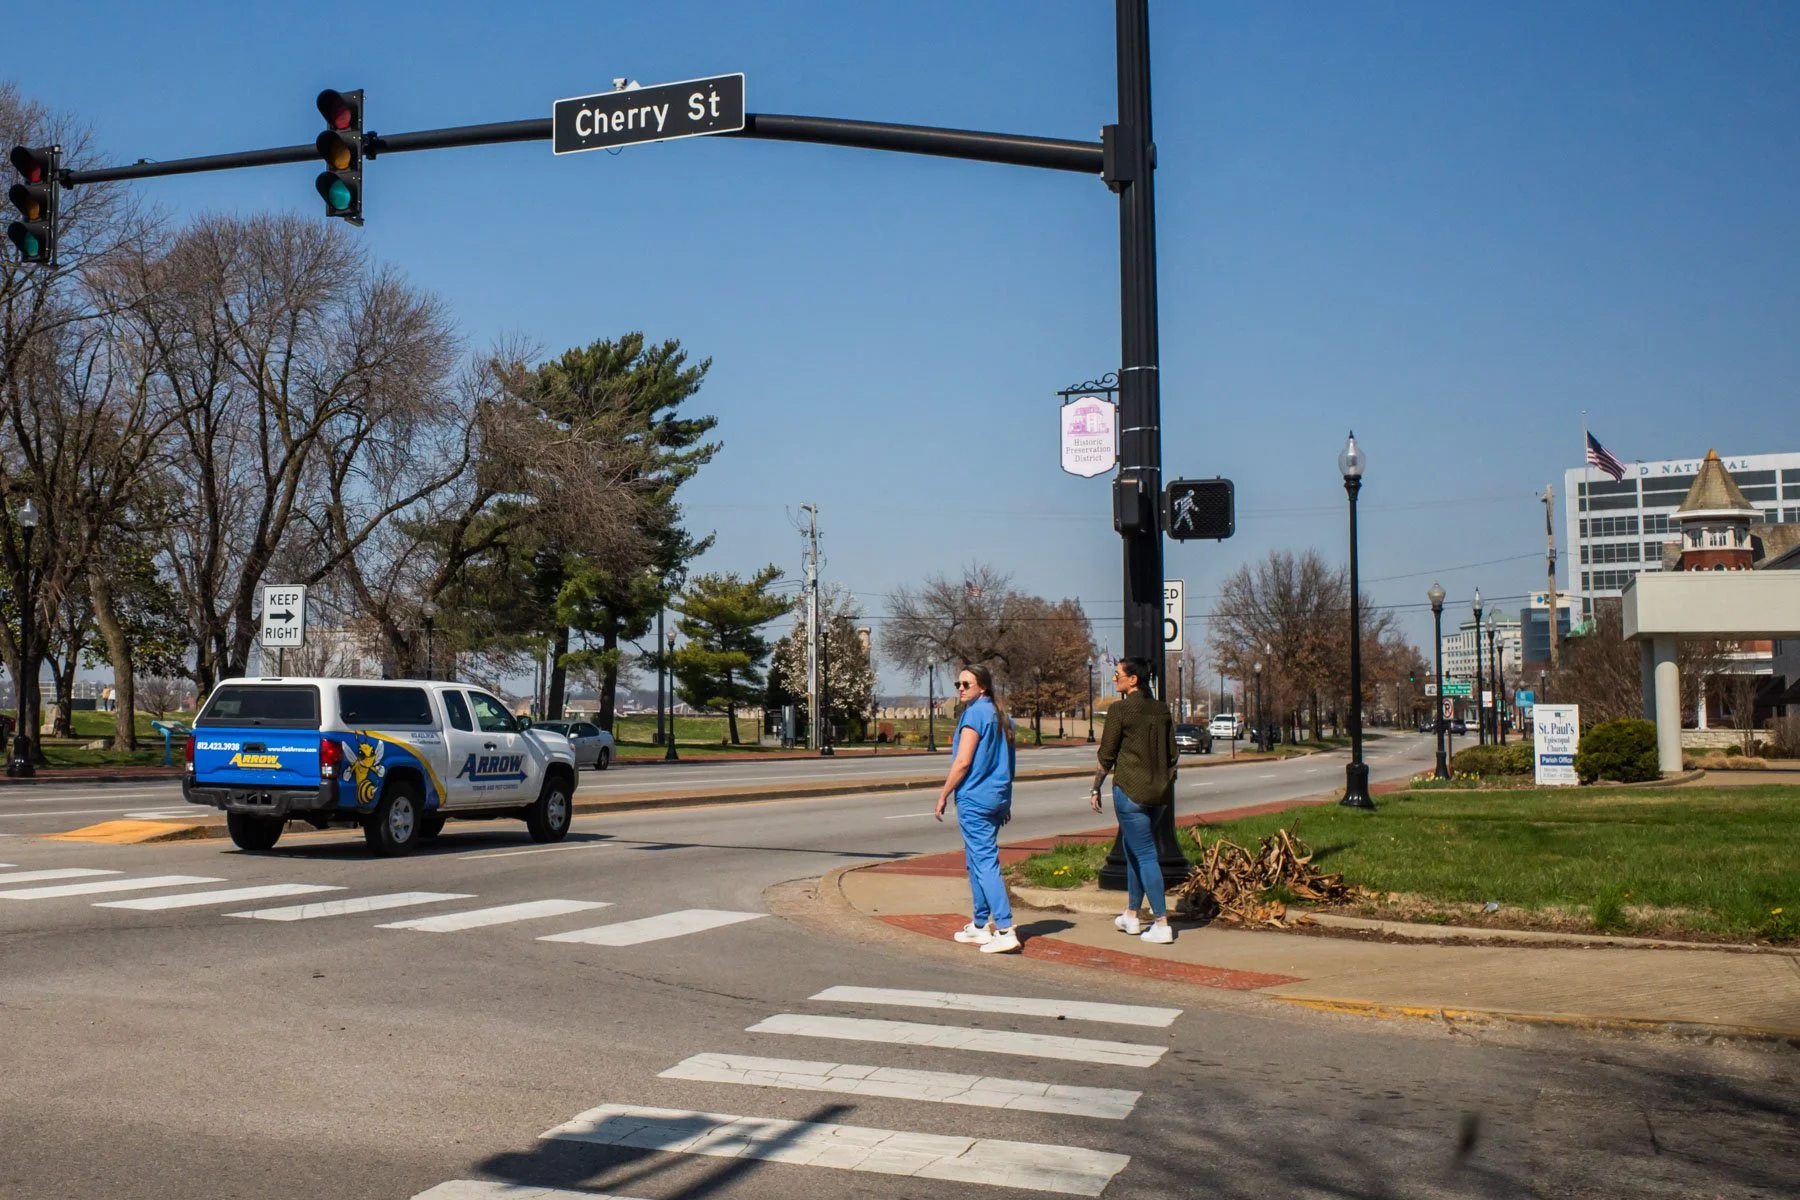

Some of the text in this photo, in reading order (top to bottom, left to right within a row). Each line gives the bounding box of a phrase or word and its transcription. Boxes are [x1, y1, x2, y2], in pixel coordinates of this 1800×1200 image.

[575, 91, 720, 136] Cherry St
[1065, 446, 1111, 454] Preservation
[1661, 461, 1748, 475] NATIAL
[270, 594, 299, 605] KEEP
[265, 627, 299, 639] RIGHT
[1539, 722, 1575, 735] St. Paul's
[1544, 736, 1570, 744] Episcopal
[197, 742, 240, 751] 812.423.3938
[1547, 745, 1568, 753] Church
[229, 753, 280, 767] ARROW
[456, 753, 525, 780] ARROW
